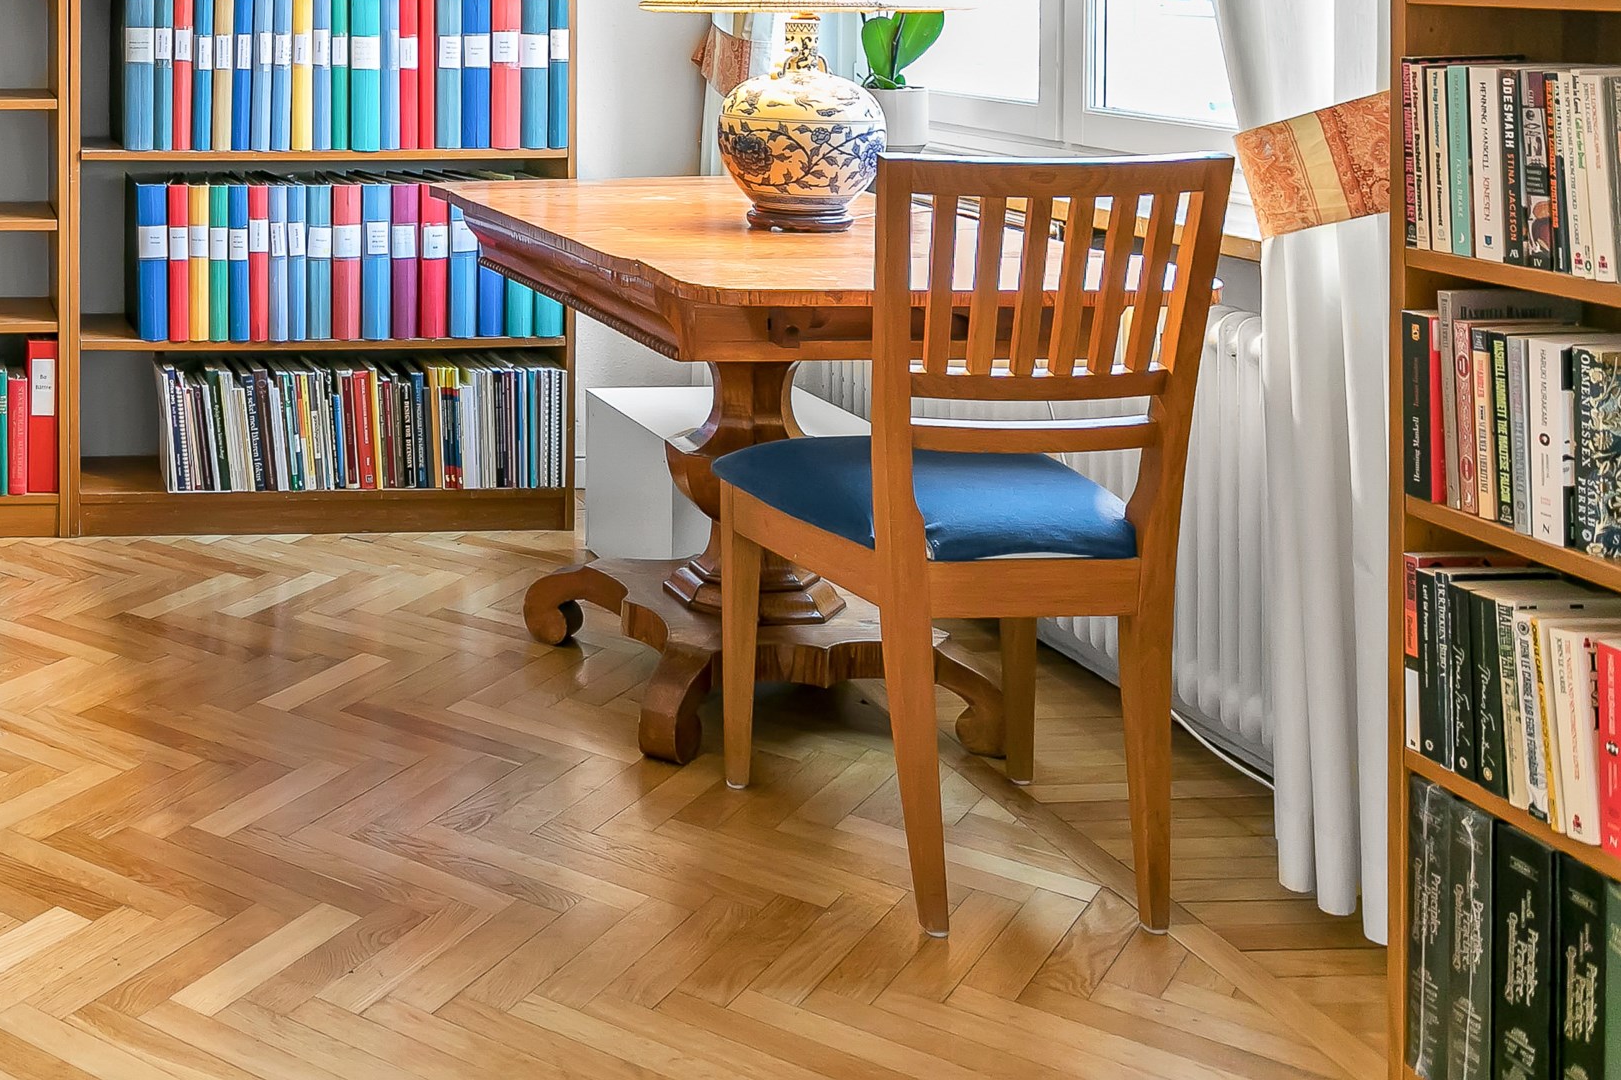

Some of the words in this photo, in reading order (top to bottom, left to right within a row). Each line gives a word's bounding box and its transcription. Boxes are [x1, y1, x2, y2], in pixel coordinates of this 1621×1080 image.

[1405, 156, 1414, 172] THE
[1481, 127, 1489, 170] MANKELL
[1507, 153, 1516, 185] STINA
[1406, 174, 1415, 204] GLASS
[1407, 205, 1416, 223] KEY
[1508, 190, 1517, 241] JACKSON
[1493, 340, 1505, 376] DASHIELL
[1495, 377, 1507, 418] HAMMETT
[1580, 354, 1590, 406] ORMEN
[1412, 416, 1420, 447] Mankell
[1497, 420, 1508, 434] THE
[1581, 421, 1591, 468] ESSEX
[1412, 449, 1421, 482] Henning
[1498, 435, 1509, 472] MALTESE
[1578, 477, 1587, 525] PERRY
[1587, 479, 1596, 527] SARAH
[1519, 638, 1529, 659] JOHN
[1521, 660, 1530, 670] LE
[1430, 873, 1441, 937] Principles
